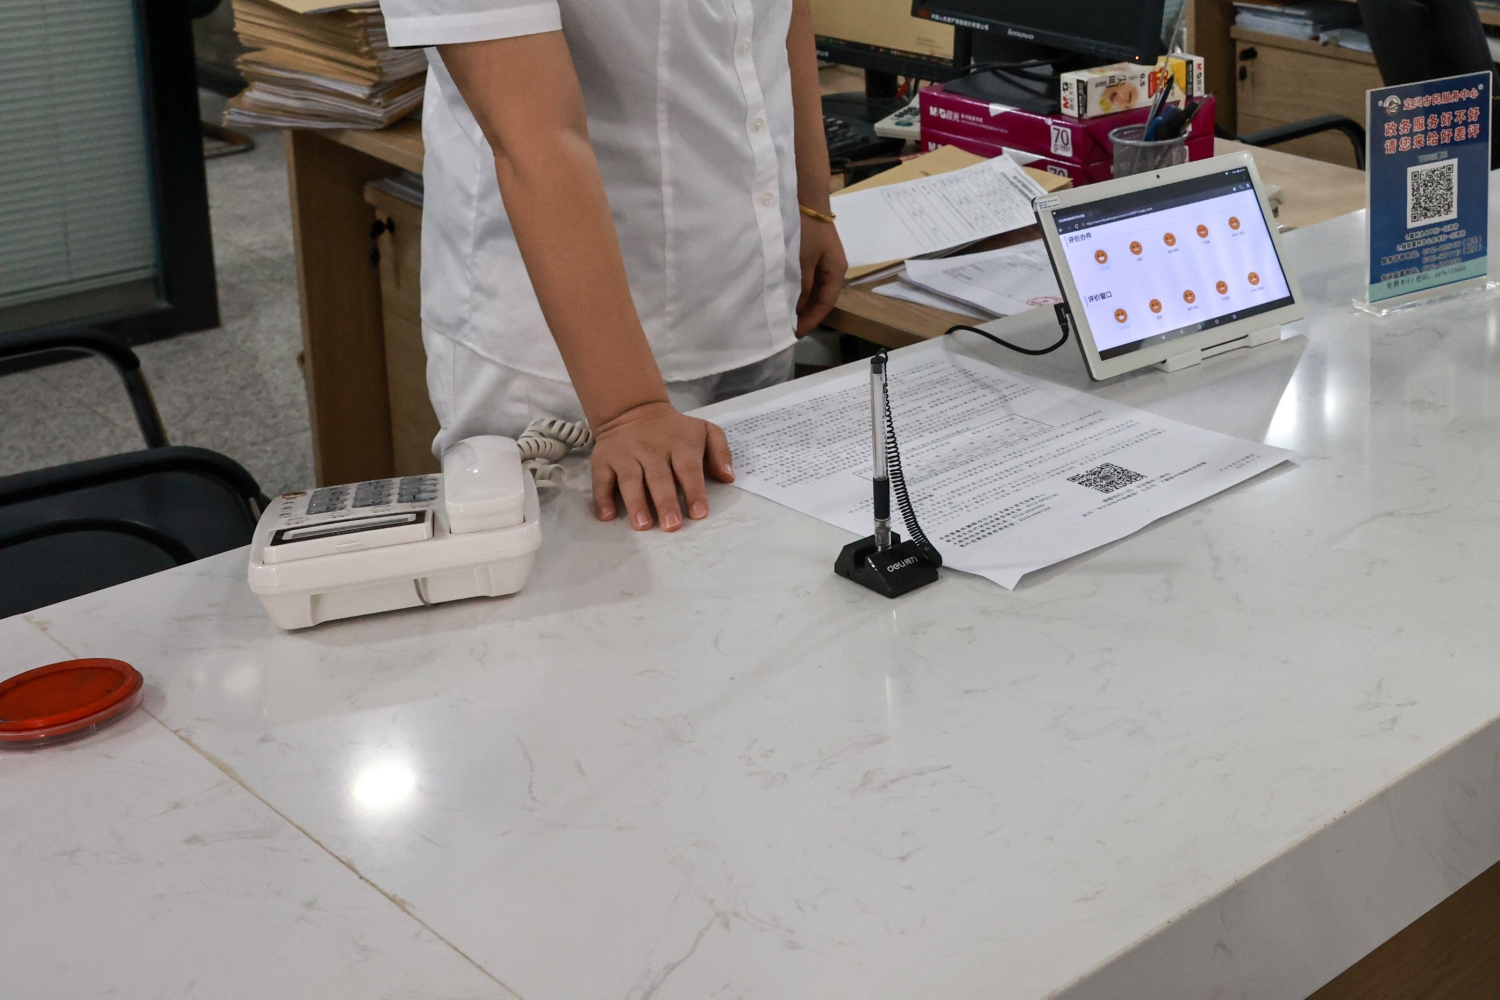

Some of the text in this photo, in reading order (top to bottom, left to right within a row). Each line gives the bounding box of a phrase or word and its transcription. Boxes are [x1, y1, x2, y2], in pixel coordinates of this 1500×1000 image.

[1007, 28, 1034, 40] lenovo
[1403, 88, 1479, 111] 定兴市民服务中心
[1384, 107, 1480, 137] 政务服务好不好
[1053, 127, 1070, 146] 70
[1384, 124, 1480, 154] 请您来给好差评
[1068, 232, 1092, 244] 评价办件
[1088, 291, 1113, 303] 评价窗口
